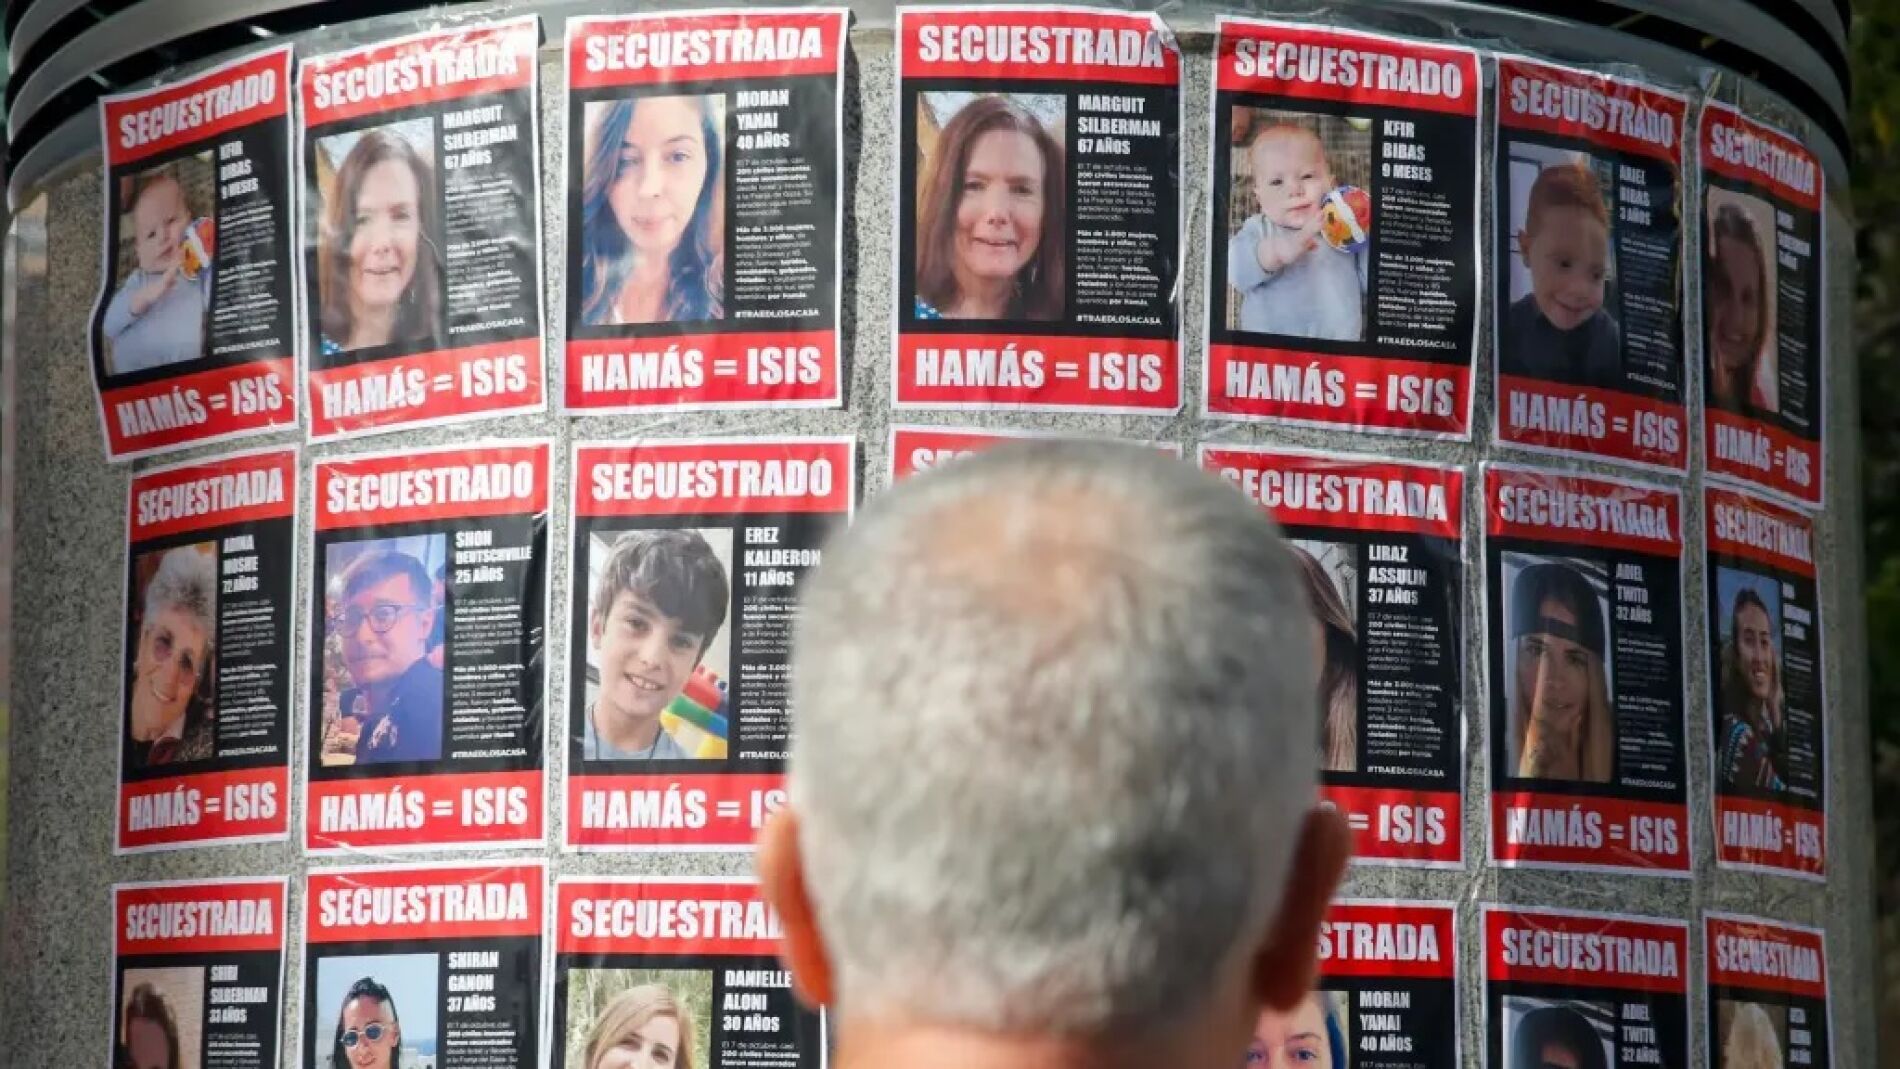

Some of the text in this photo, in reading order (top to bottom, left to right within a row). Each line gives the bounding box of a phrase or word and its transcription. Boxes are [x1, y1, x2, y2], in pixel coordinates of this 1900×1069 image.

[585, 25, 822, 72] SECUESTRADA
[918, 25, 1164, 69] SECUESTRADA
[313, 43, 519, 108] SECUESTRADA
[1235, 40, 1463, 99] SECUESTRADO
[120, 68, 276, 148] SECUESTRADO
[736, 89, 790, 108] MORAN
[1077, 94, 1145, 113] MARGUIT
[443, 104, 503, 129] MARGUIT
[736, 111, 778, 131] YANAI
[1077, 116, 1161, 136] SILBERMAN
[1511, 78, 1674, 149] SECUESTRADO
[444, 124, 518, 152] SILBERMAN
[736, 131, 790, 149] 40 AÑOS
[1383, 119, 1415, 138] KFIR
[460, 149, 493, 169] AÑOS
[1077, 136, 1131, 154] 67 AÑOS
[1382, 142, 1426, 162] BIBAS
[1381, 162, 1433, 182] 9 MESES
[581, 344, 822, 393] HAMÁS = ISIS
[915, 342, 1162, 393] HAMÁS = ISIS
[323, 355, 528, 419] HAMÁS = ISIS
[1225, 358, 1455, 417] HAMÁS = ISIS
[117, 373, 282, 438] HAMÁS = ISIS
[1510, 391, 1680, 457] HAMÁS = ISIS
[1714, 420, 1771, 472] HAMÁS
[1785, 447, 1811, 488] ISIS
[326, 461, 533, 513] SECUESTRADO
[592, 459, 832, 500] SECUESTRADO
[137, 467, 285, 527] SECUESTRADA
[1499, 485, 1671, 542] SECUESTRADA
[455, 530, 493, 549] SHON
[745, 527, 779, 545] EREZ
[744, 548, 821, 567] KALDERON
[1368, 544, 1408, 563] LIRAZ
[455, 566, 504, 584] 25 AÑOS
[744, 570, 795, 586] 11 AÑOS
[1368, 566, 1427, 587] ASSULIN
[1368, 587, 1419, 606] 37 AÑOS
[128, 781, 277, 832] HAMÁS = ISIS
[320, 786, 528, 832] HAMÁS = ISIS
[582, 783, 708, 830] HAMÁS
[717, 800, 741, 817] =
[1378, 804, 1446, 846] ISIS
[1507, 804, 1680, 855] HAMÁS = ISIS
[1722, 810, 1784, 852] HAMÁS
[1795, 822, 1821, 858] ISIS
[320, 883, 528, 927] SECUESTRADA
[126, 898, 274, 941] SECUESTRADA
[1316, 922, 1440, 962] STRADA
[1502, 927, 1678, 977] SECUESTRADA
[448, 950, 500, 970] SHIRAN
[1717, 935, 1820, 983] SECUESTRADA
[448, 973, 495, 992] GANON
[724, 970, 792, 988] DANIELLE
[446, 994, 496, 1012] 37 AÑOS
[723, 993, 767, 1011] ALONI
[1359, 990, 1411, 1009] MORAN
[723, 1014, 780, 1032] 30 AÑOS
[1359, 1014, 1400, 1031] YANAI
[1360, 1036, 1413, 1052] 40 AÑOS
